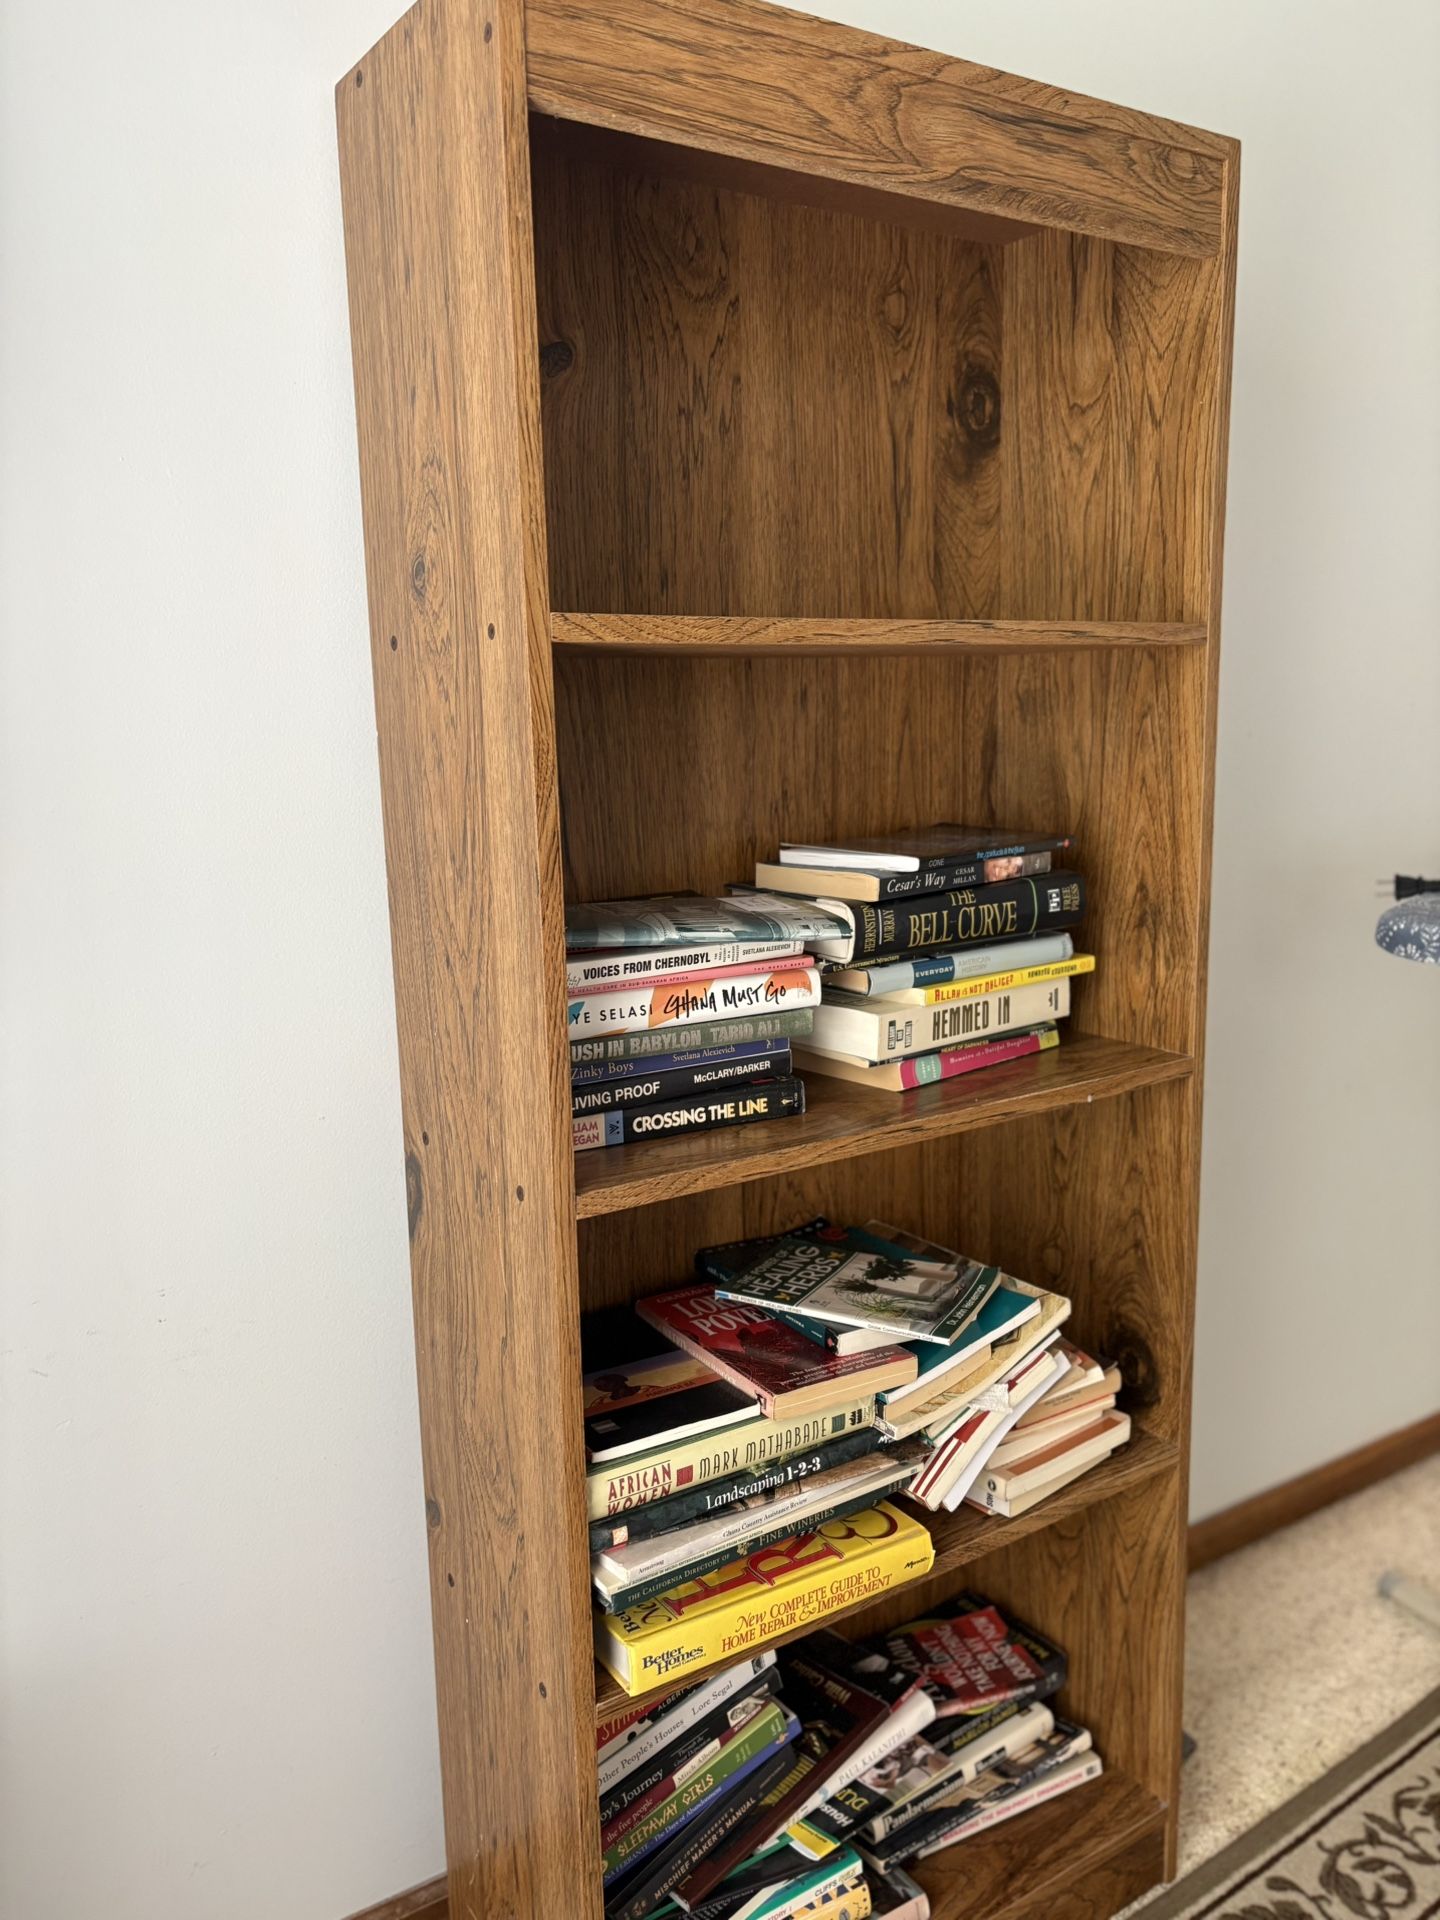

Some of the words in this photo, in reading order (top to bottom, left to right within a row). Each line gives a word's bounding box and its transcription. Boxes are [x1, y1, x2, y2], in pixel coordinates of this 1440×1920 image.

[887, 875, 922, 893] Cesar's
[925, 872, 946, 888] Way
[953, 875, 977, 885] MILLAN
[955, 866, 975, 876] CESAR
[946, 889, 977, 906] THE
[883, 910, 896, 942] MURRAY
[908, 910, 954, 948] BELL
[958, 901, 1018, 939] CURVE
[583, 964, 620, 981] VOICES
[623, 959, 652, 976] FROM
[655, 952, 711, 970] CHERNOBYL
[915, 966, 954, 978] EVERYDAY
[600, 1004, 653, 1022] SELASI
[663, 987, 717, 1018] GHANA
[934, 989, 961, 1002] ALLAH
[969, 983, 983, 994] NOT
[932, 1000, 990, 1041] HEMMED
[997, 995, 1011, 1026] IN
[571, 1042, 604, 1063] USH
[607, 1039, 624, 1058] IN
[630, 1029, 701, 1055] BABYLON
[757, 1019, 780, 1037] ALI
[570, 1064, 604, 1080] Zinky
[608, 1062, 634, 1076] Boys
[672, 1051, 701, 1063] Svetlana
[701, 1045, 736, 1058] Alexievich
[615, 1081, 660, 1103] PROOF
[694, 1060, 771, 1084] McCLARY/BARKER
[632, 1107, 706, 1133] CROSSING
[708, 1102, 735, 1121] THE
[738, 1097, 768, 1117] LINE
[742, 1246, 820, 1296] HEALING
[777, 1256, 840, 1295] HERBS
[699, 1448, 738, 1480] MARK
[745, 1417, 828, 1464] MATHABANE
[607, 1484, 672, 1517] WOMEN
[608, 1463, 672, 1501] AFRICAN
[705, 1472, 784, 1511] Landscaping
[787, 1456, 821, 1481] 1-2-3
[741, 1518, 763, 1530] Country
[763, 1505, 790, 1521] Assistance
[627, 1592, 641, 1603] THE
[642, 1574, 683, 1596] CALIFORNIA
[684, 1557, 721, 1578] DIRECTORY
[721, 1553, 730, 1561] OF
[759, 1528, 784, 1546] FINE
[786, 1506, 836, 1535] WINERIES
[722, 1627, 756, 1652] HOME
[759, 1614, 797, 1638] REPAIR
[799, 1606, 817, 1622] &
[817, 1573, 893, 1614] IMPROVEMENT
[735, 1611, 767, 1633] New
[770, 1585, 827, 1619] COMPLETE
[830, 1572, 864, 1595] GUIDE
[865, 1566, 881, 1582] TO
[642, 1645, 685, 1670] Better
[657, 1645, 704, 1676] Homes
[620, 1740, 654, 1770] People's
[654, 1719, 685, 1745] Houses
[691, 1697, 711, 1717] Lore
[711, 1681, 734, 1701] Segal
[677, 1762, 697, 1784] Mitch
[697, 1745, 719, 1765] Albom
[838, 1762, 862, 1786] PAUL
[600, 1800, 621, 1823] oy's
[620, 1767, 664, 1808] Journey
[606, 1830, 619, 1843] the
[618, 1818, 632, 1832] five
[631, 1797, 653, 1823] people
[617, 1801, 678, 1857] SLEEPAWAY
[682, 1773, 715, 1805] GIRLS
[654, 1832, 665, 1843] The
[685, 1786, 722, 1817] Abandonment
[654, 1859, 691, 1900] MISCHIEF
[691, 1828, 725, 1862] MAKER'S
[725, 1797, 756, 1828] MANUAL
[671, 1858, 682, 1871] SIR
[683, 1843, 699, 1858] JOHN
[814, 1880, 838, 1897] CLIFFS
